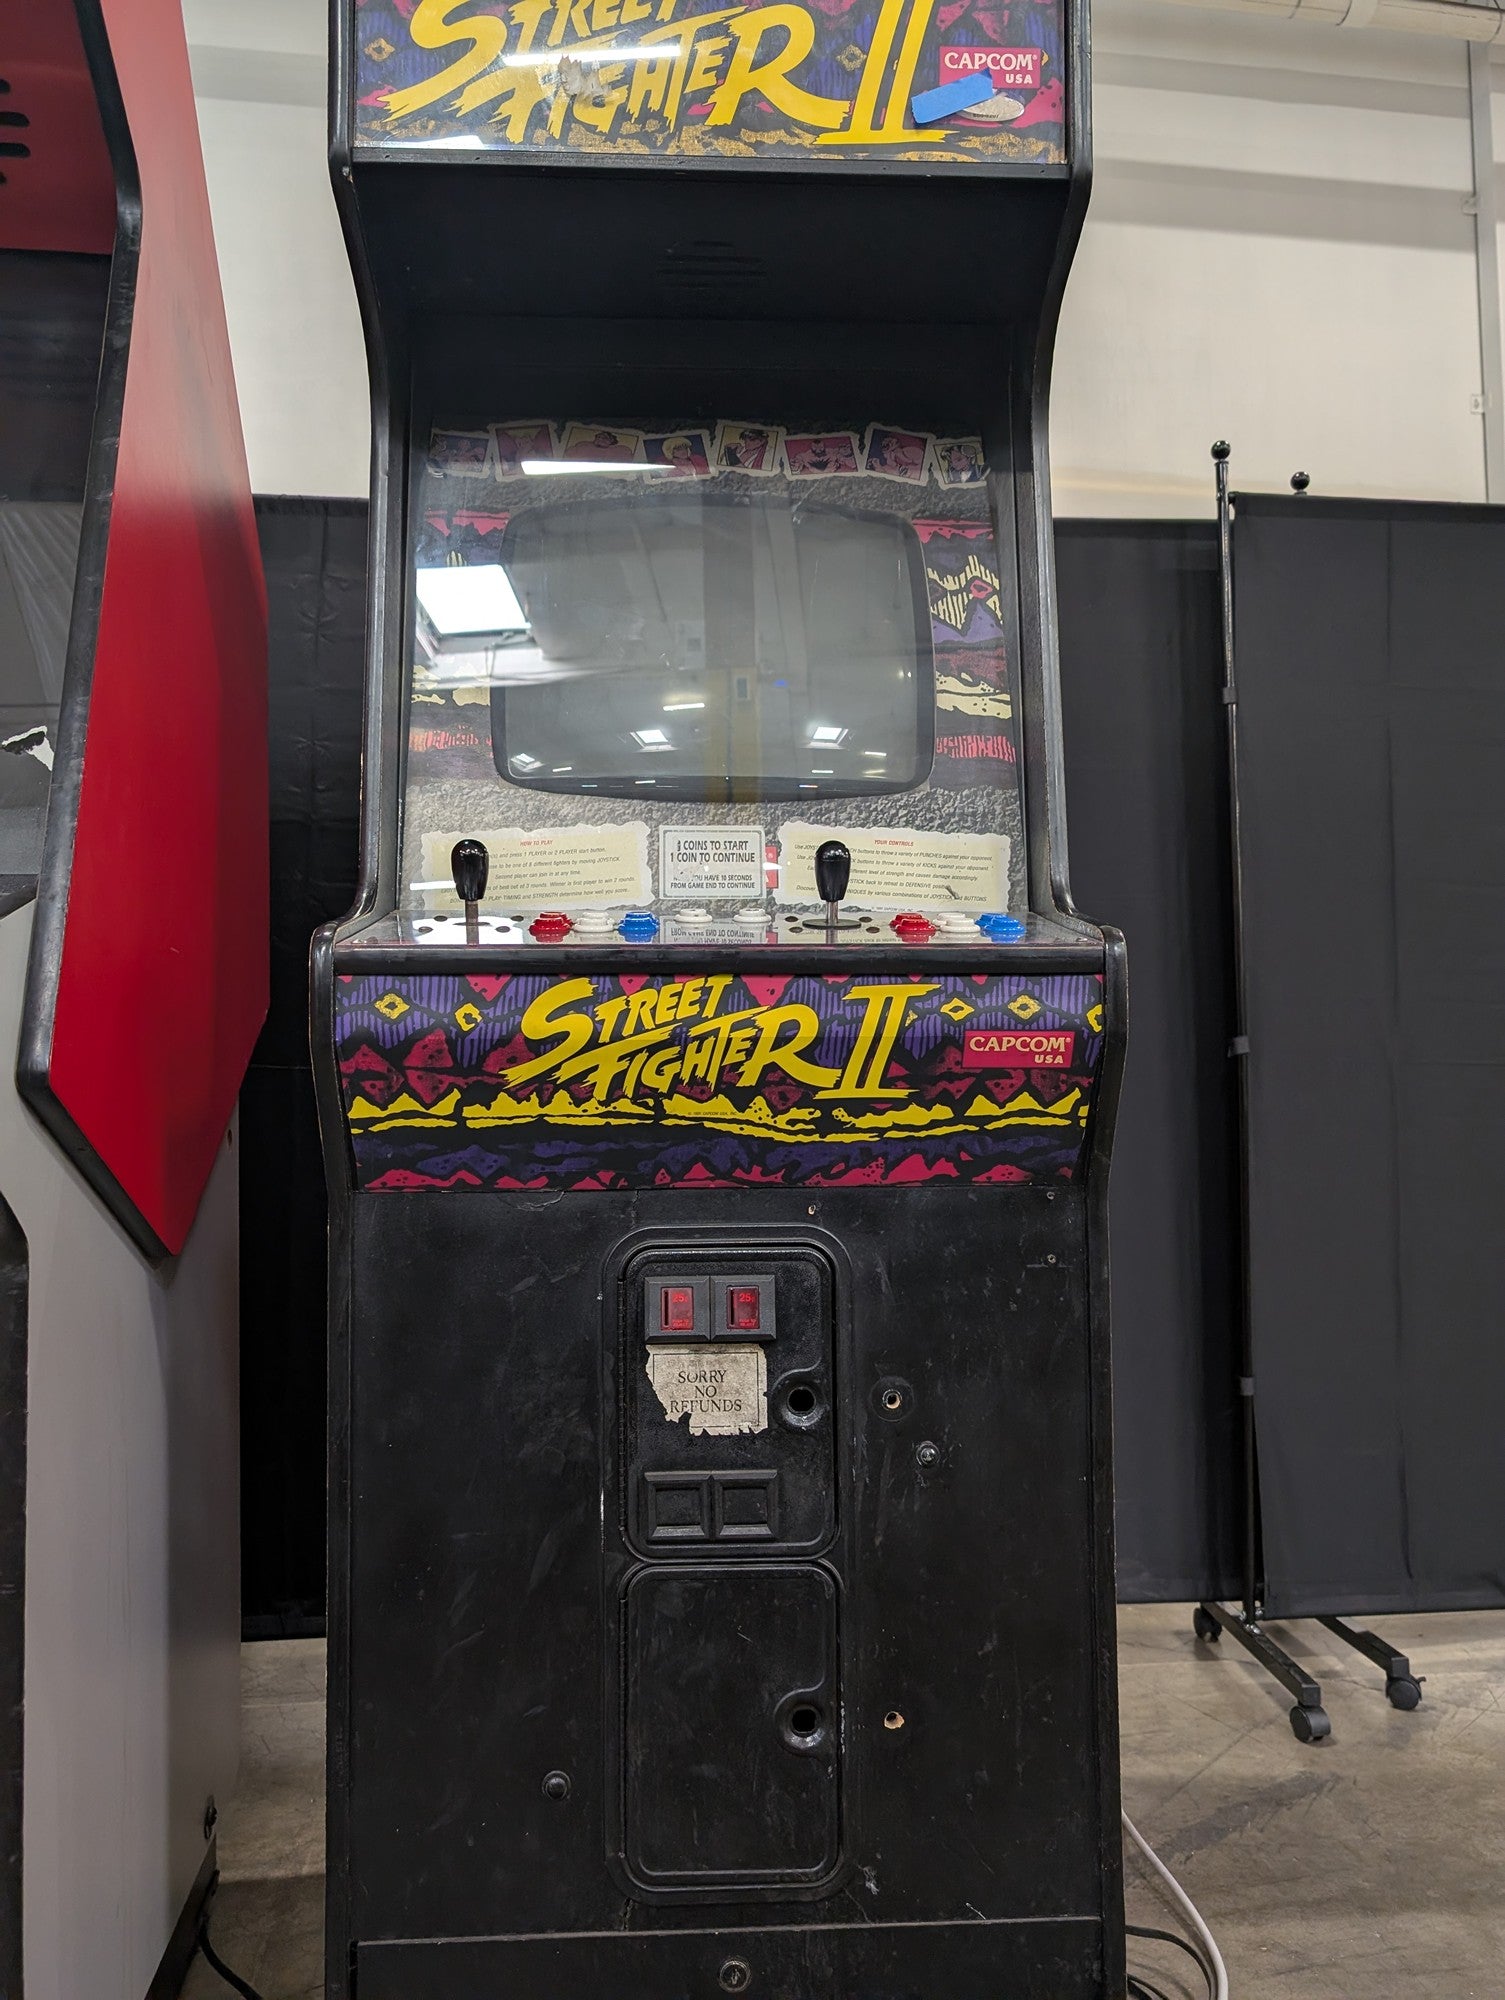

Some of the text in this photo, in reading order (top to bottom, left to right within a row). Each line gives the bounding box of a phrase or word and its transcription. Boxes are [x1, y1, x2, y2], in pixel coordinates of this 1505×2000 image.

[442, 0, 961, 145] FIGHTER II
[1005, 73, 1033, 84] USA
[683, 840, 708, 851] COINS
[710, 840, 721, 851] TO
[723, 840, 749, 851] START
[509, 852, 522, 860] press
[670, 852, 755, 863] 1 COIN TO CONTINUE
[499, 974, 735, 1090] STREET
[546, 983, 943, 1102] FIGHTER II
[1034, 1054, 1064, 1064] USA
[678, 1369, 727, 1384] SORRY
[695, 1385, 717, 1398] NO
[670, 1399, 742, 1413] REFUNDS
